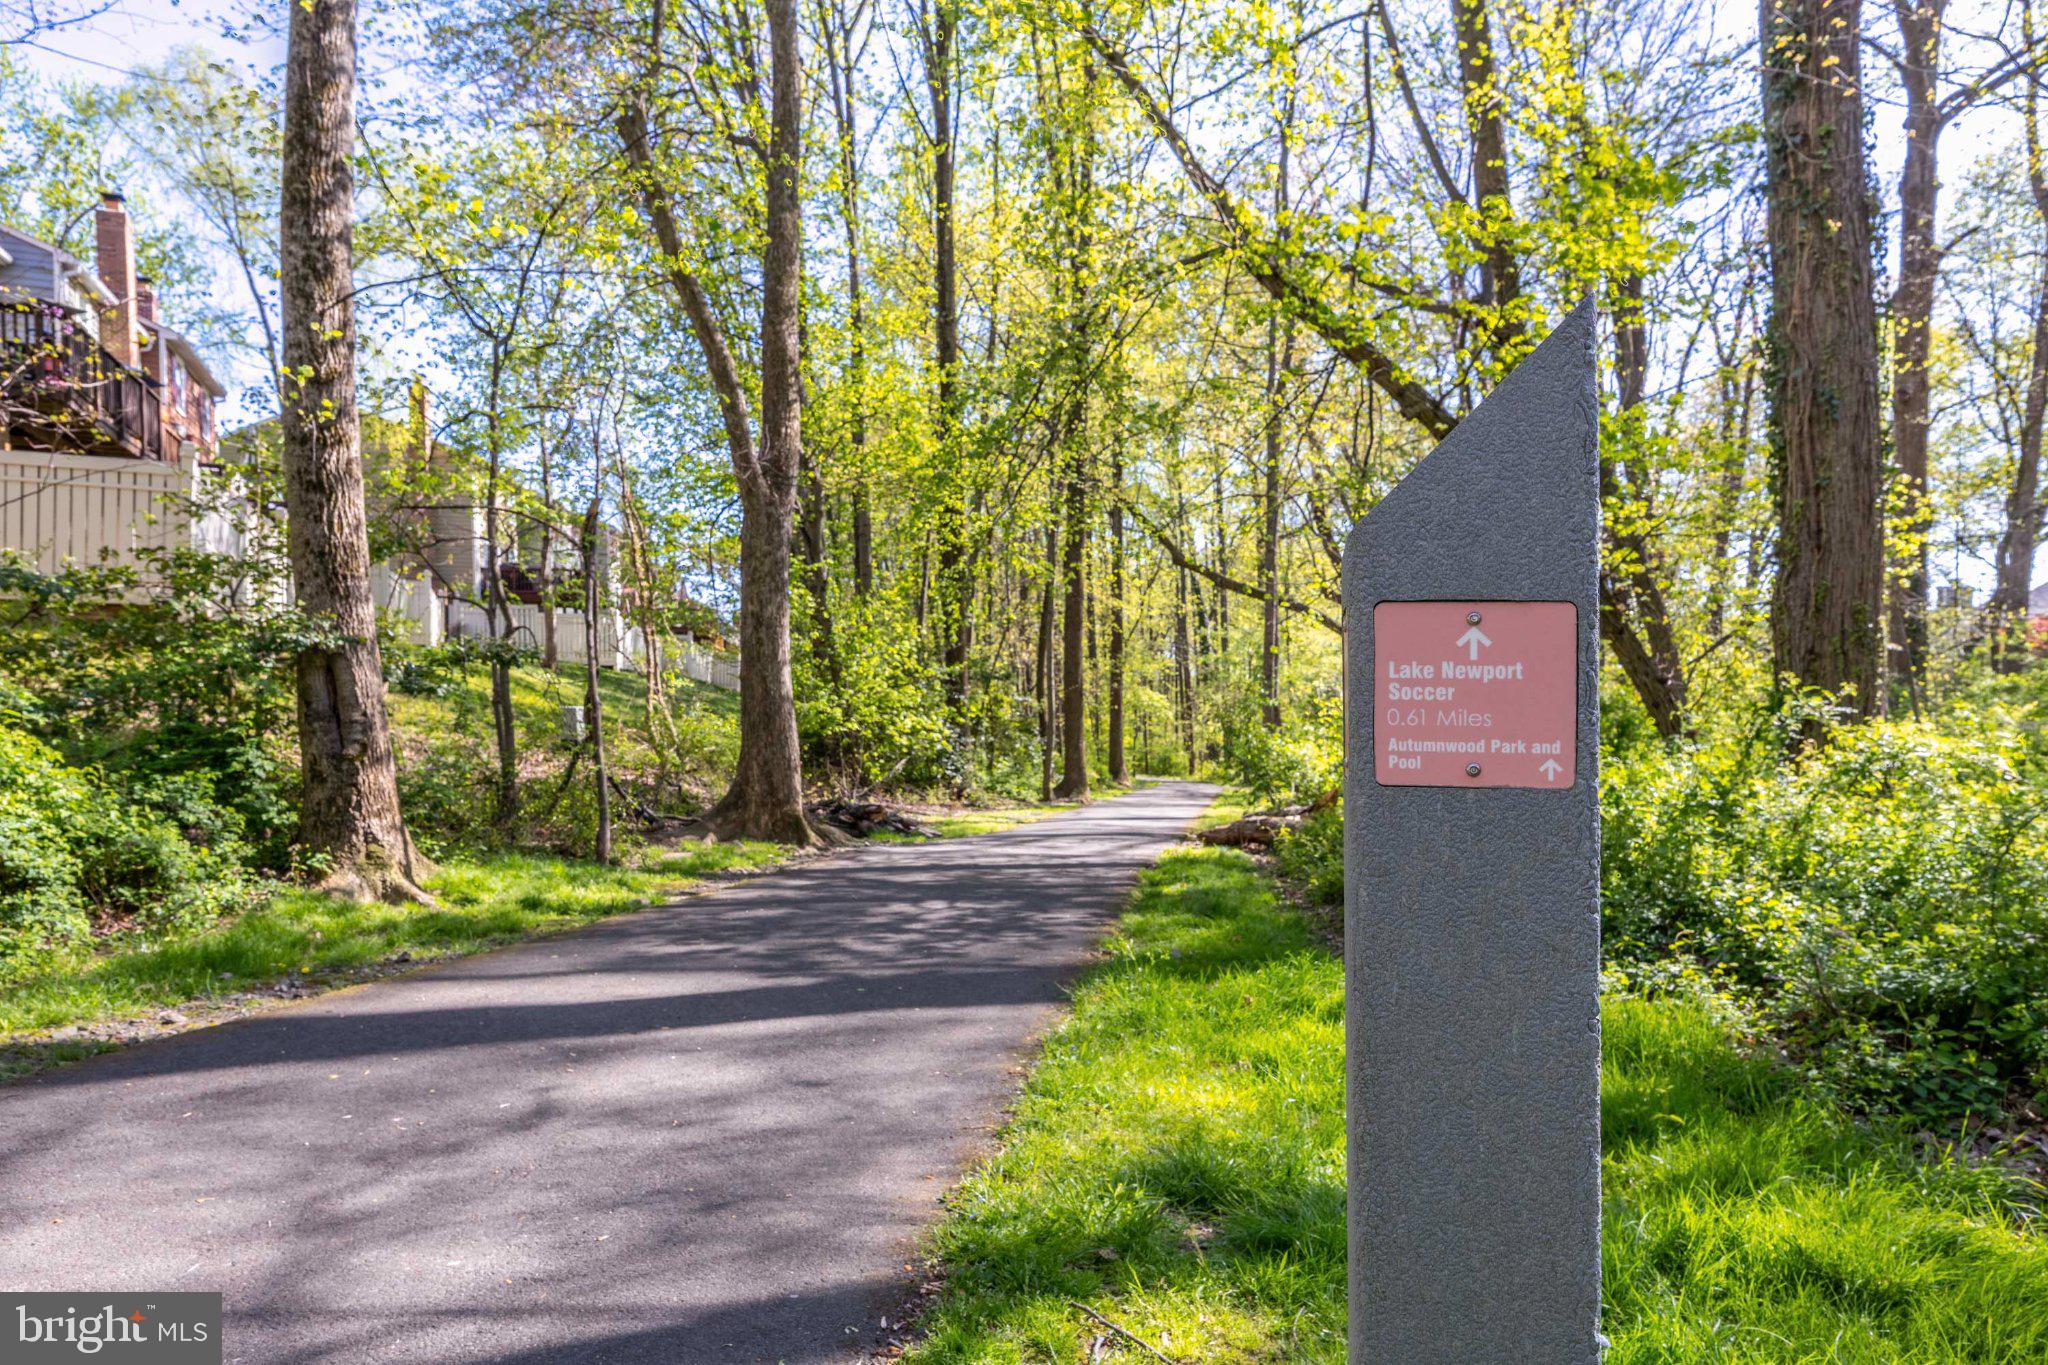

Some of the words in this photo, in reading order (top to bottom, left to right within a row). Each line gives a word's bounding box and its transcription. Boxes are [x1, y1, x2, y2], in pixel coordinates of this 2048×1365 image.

[1388, 661, 1434, 679] Lake
[1441, 661, 1523, 683] Newport
[1388, 683, 1455, 701] Soccer
[1387, 708, 1426, 726] 0.61
[1436, 709, 1492, 727] Miles
[1388, 738, 1485, 753] Autumnwood
[1491, 739, 1526, 754] Park
[1532, 740, 1561, 755] and
[1388, 755, 1421, 770] Pool
